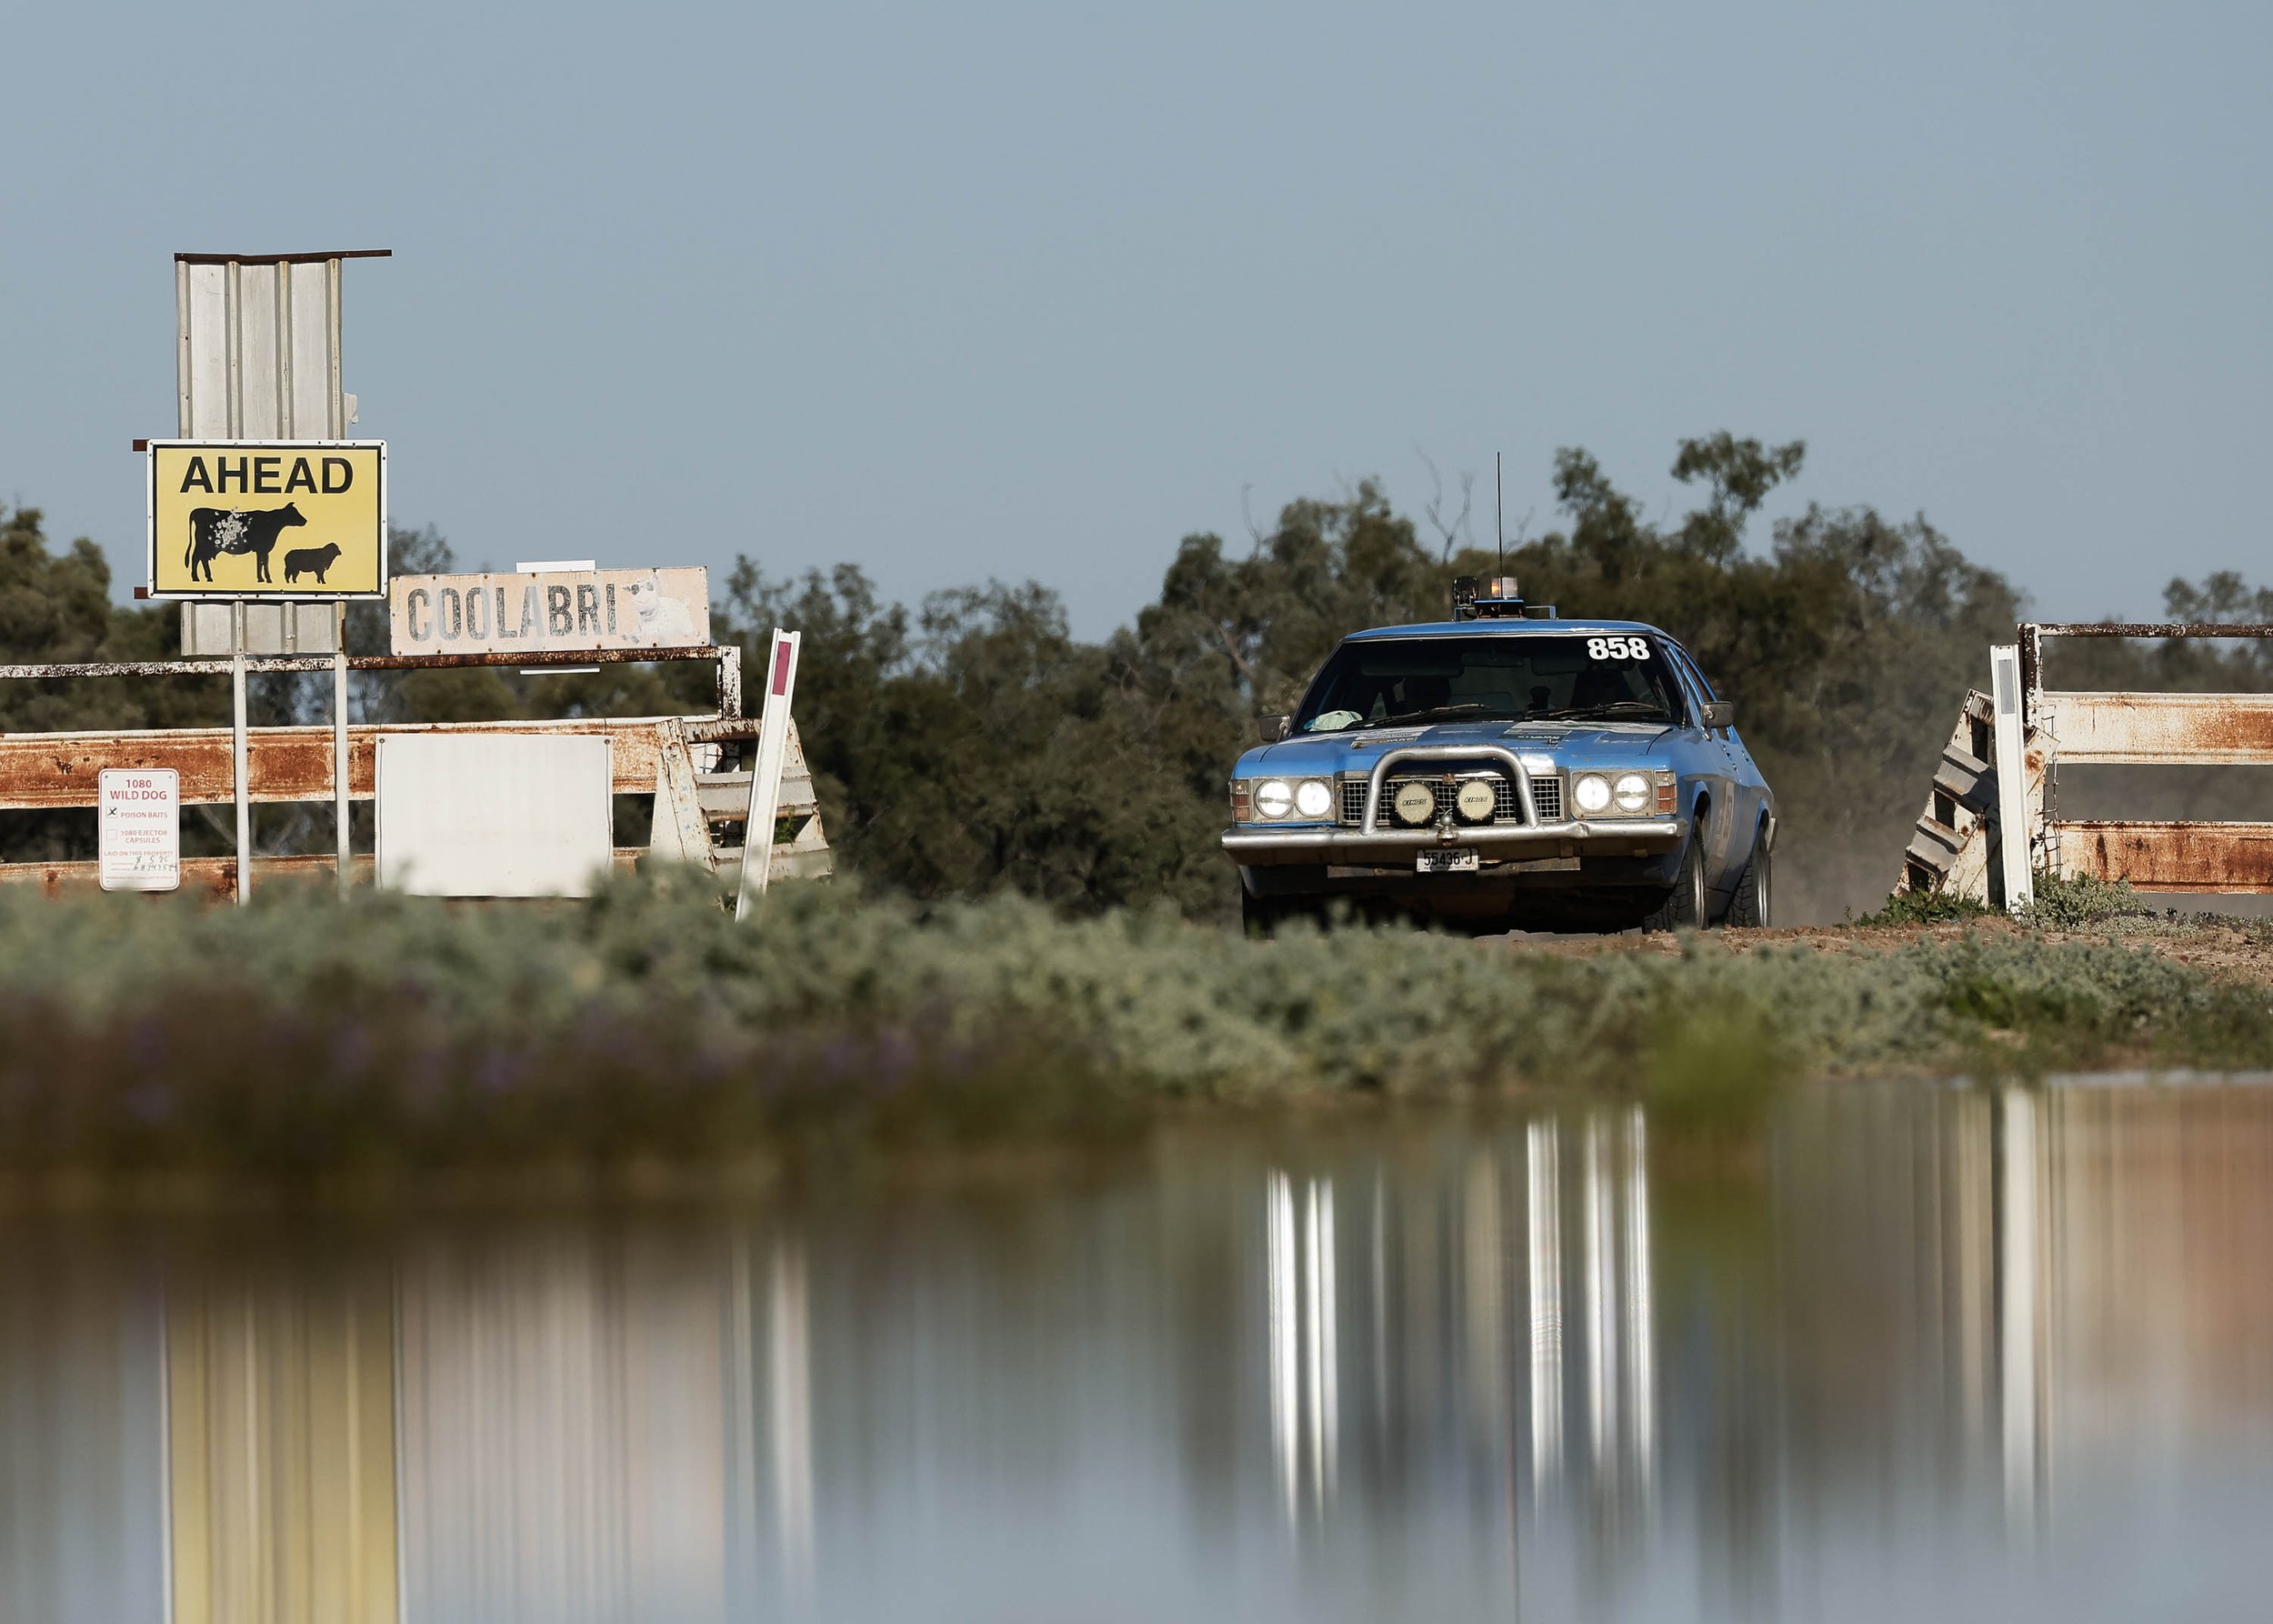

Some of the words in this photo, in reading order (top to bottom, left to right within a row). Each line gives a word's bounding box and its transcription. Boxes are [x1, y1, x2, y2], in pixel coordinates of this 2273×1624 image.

[179, 456, 354, 495] AHEAD
[406, 583, 617, 642] COOLABRI
[1587, 637, 1650, 660] 858
[125, 779, 152, 788] 1080
[110, 790, 139, 800] WILD
[141, 790, 167, 800] DOG
[1402, 798, 1428, 807] KINGS
